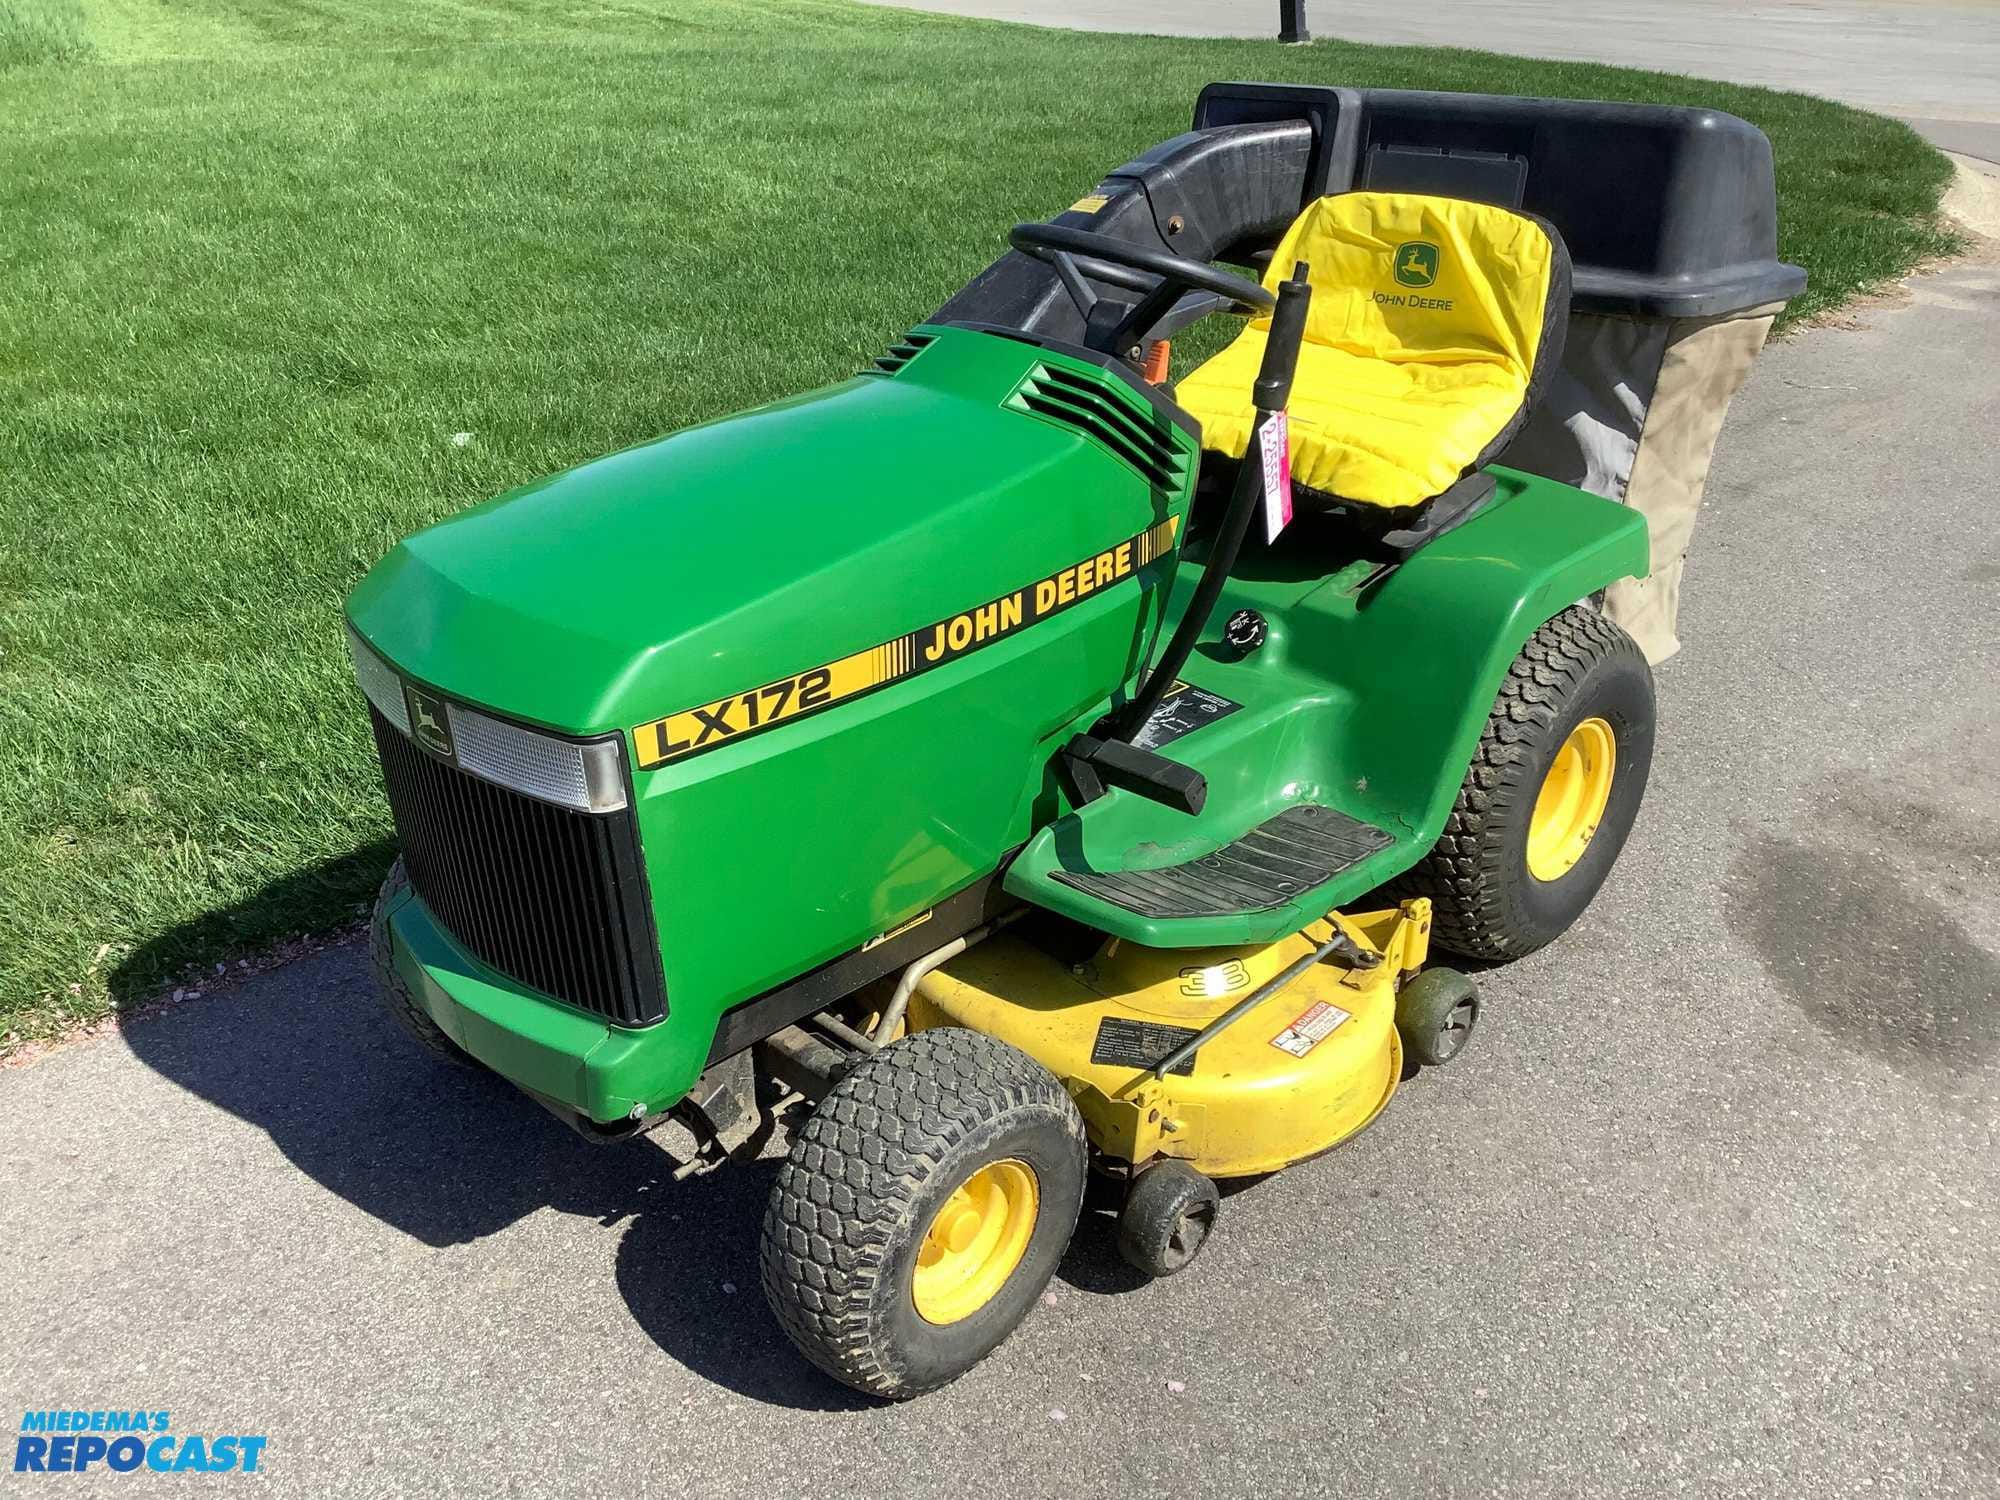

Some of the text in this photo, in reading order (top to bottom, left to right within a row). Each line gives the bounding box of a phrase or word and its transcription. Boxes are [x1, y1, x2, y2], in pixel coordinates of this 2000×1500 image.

[1366, 290, 1454, 311] JOHN DEERE
[925, 541, 1132, 662] JOHN DEERE
[655, 667, 832, 758] LX172
[1179, 957, 1251, 997] 38
[1298, 1002, 1329, 1030] DANGER
